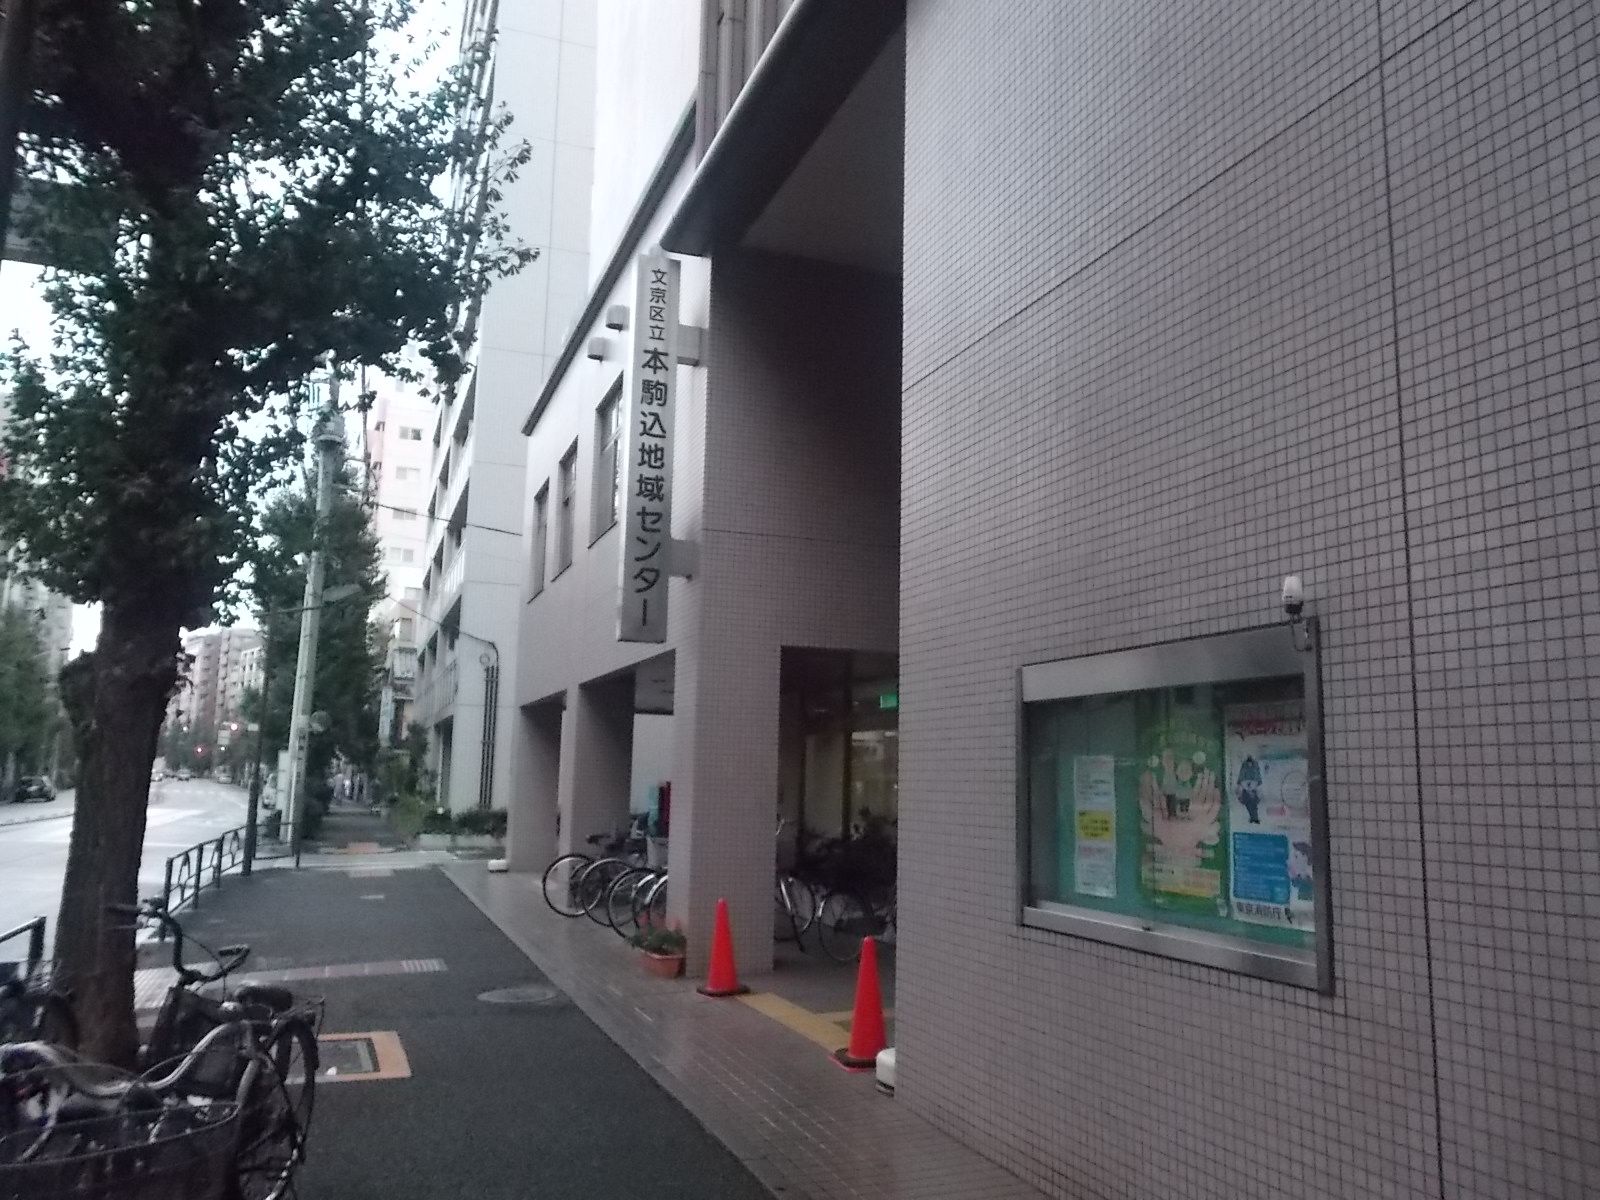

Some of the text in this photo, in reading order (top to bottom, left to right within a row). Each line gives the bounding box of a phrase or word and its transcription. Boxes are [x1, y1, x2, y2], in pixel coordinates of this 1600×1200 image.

[633, 268, 669, 627] 文京区立本駒込地域センター
